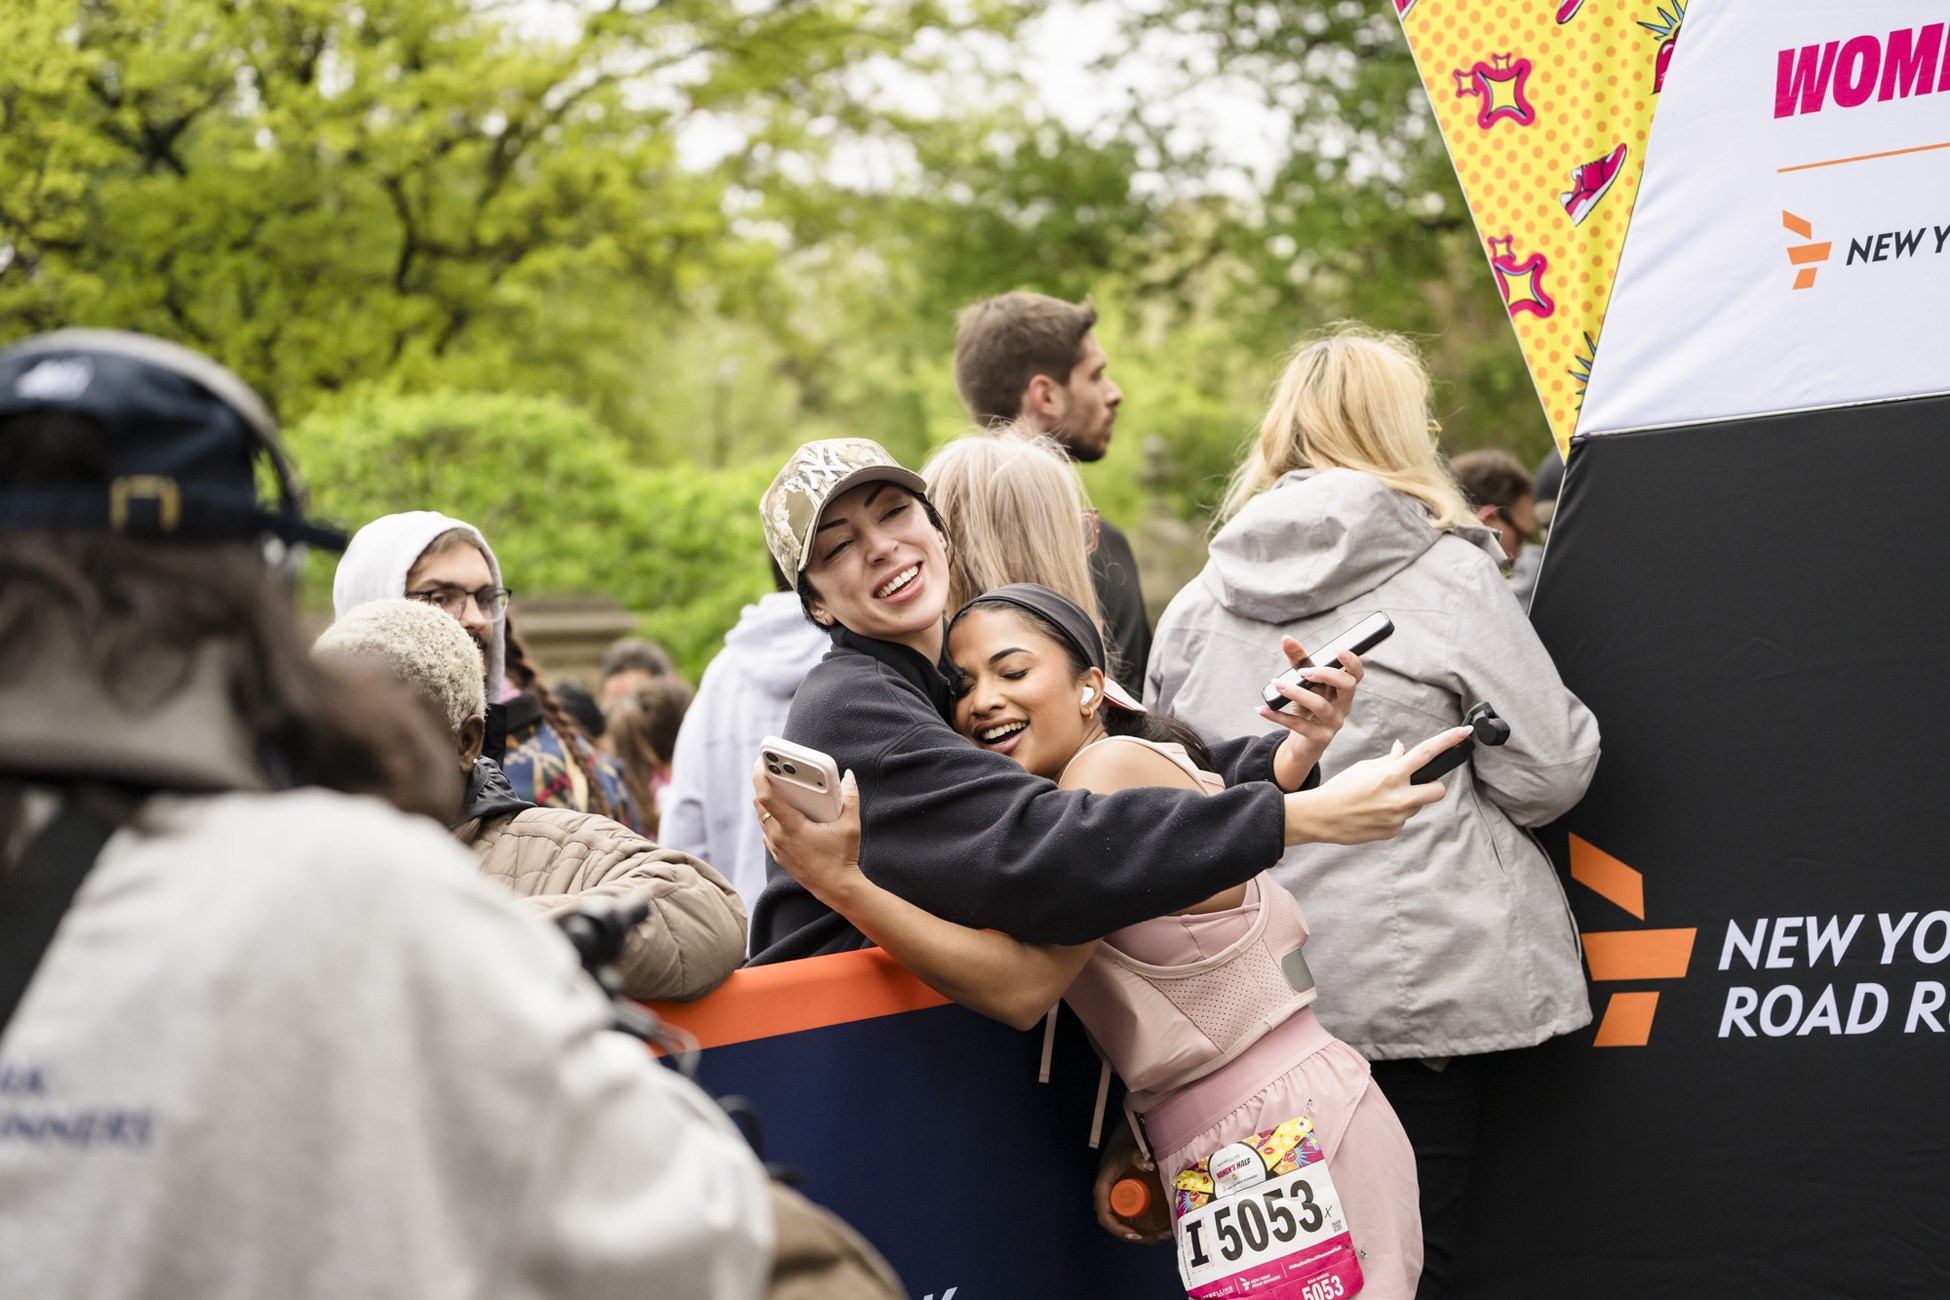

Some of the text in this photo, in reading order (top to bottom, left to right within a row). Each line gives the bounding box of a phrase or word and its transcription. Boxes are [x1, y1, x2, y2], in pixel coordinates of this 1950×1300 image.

[1846, 227, 1927, 266] NEW
[1718, 910, 1950, 971] NEW YO
[1718, 981, 1950, 1038] ROAD R
[1236, 1157, 1251, 1169] HALF
[1186, 1219, 1209, 1268] I
[1214, 1180, 1323, 1261] 5053
[1301, 1275, 1344, 1300] 5053
